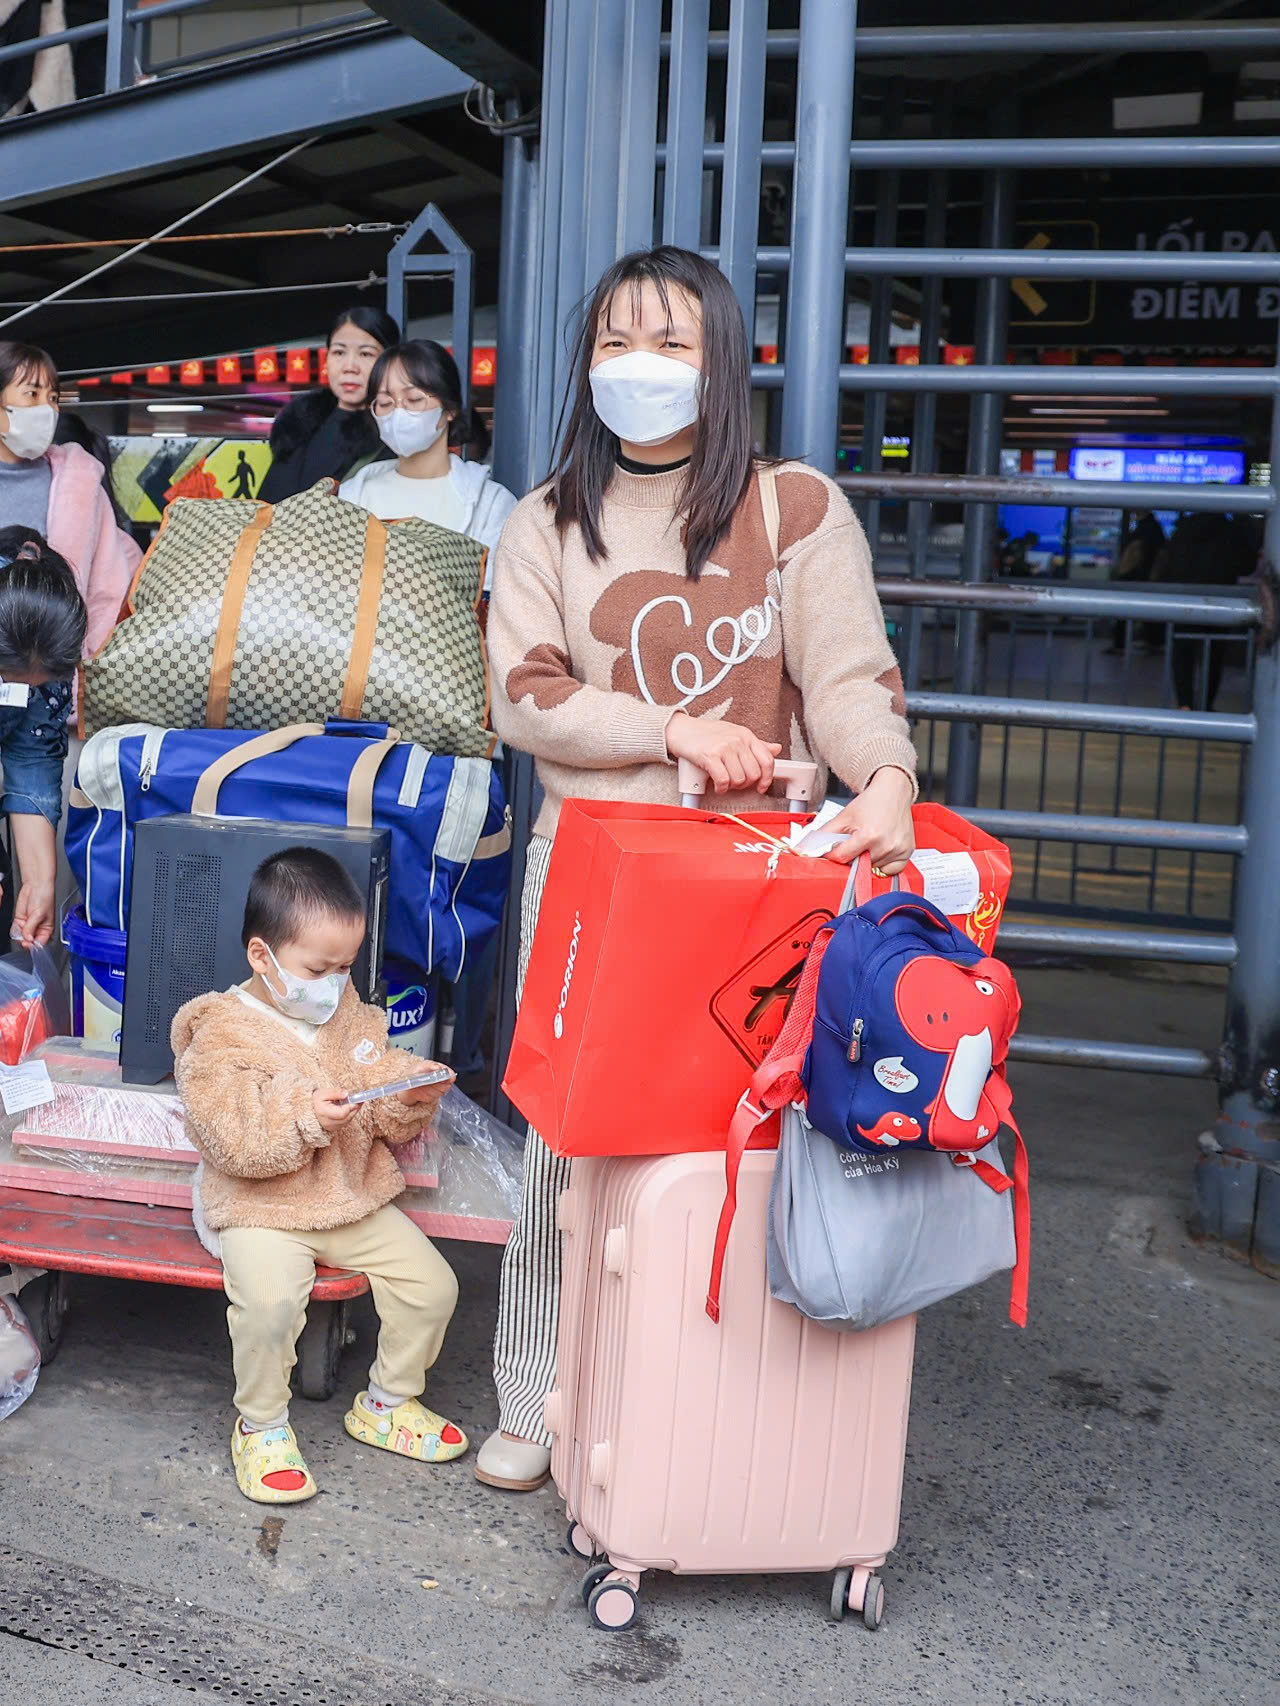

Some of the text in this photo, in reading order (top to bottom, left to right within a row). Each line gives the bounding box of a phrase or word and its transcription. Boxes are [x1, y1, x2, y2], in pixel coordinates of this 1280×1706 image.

[387, 1007, 418, 1028] lux
[844, 1166, 863, 1178] của
[864, 1164, 883, 1175] Hoa
